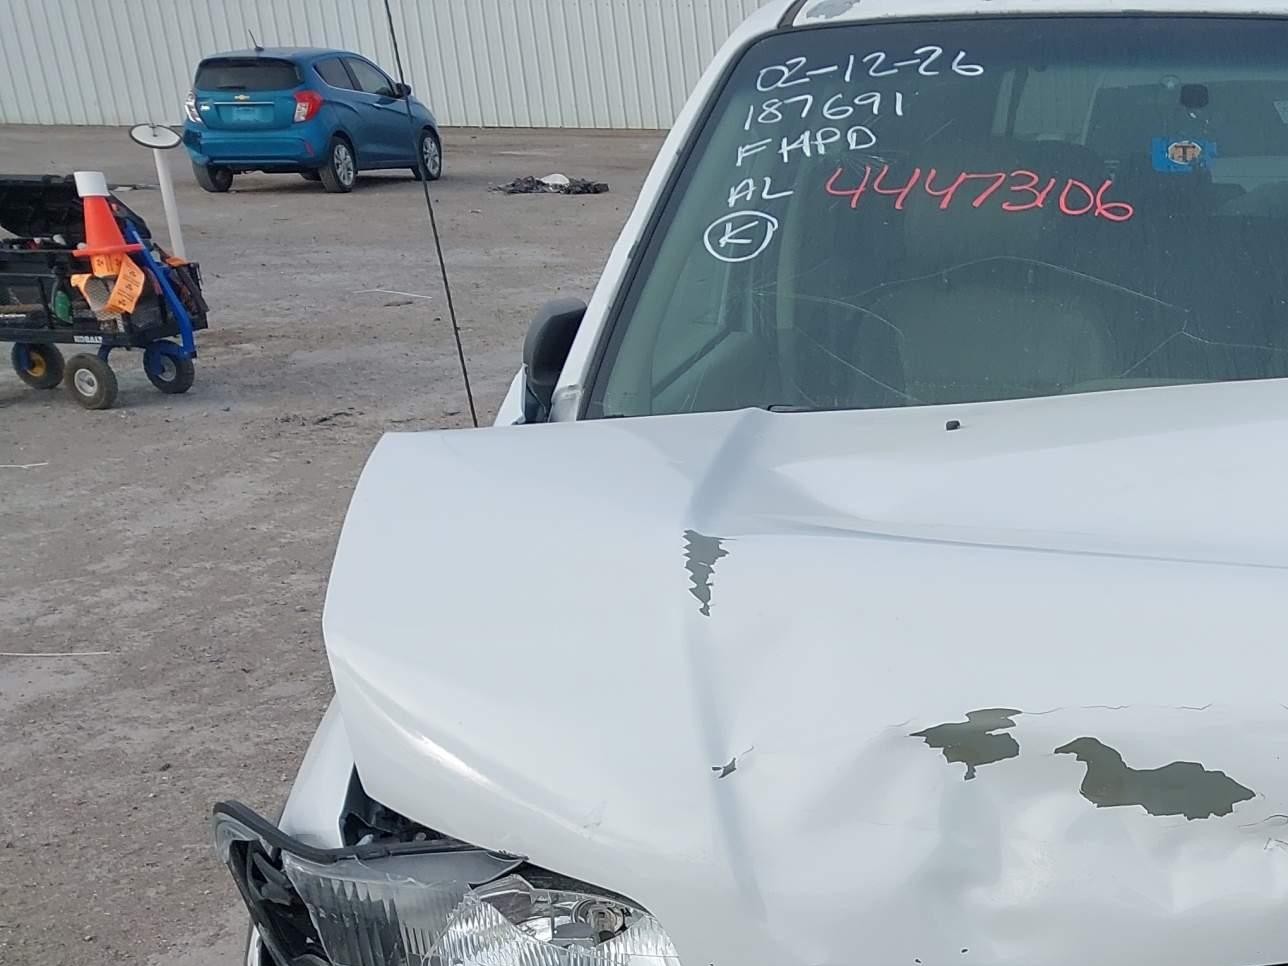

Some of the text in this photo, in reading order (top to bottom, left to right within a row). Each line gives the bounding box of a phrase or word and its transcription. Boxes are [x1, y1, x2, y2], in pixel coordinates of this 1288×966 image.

[756, 46, 985, 92] 02-12-26
[743, 91, 904, 131] 187691
[728, 177, 794, 208] AL
[825, 164, 1133, 221] 44473106
